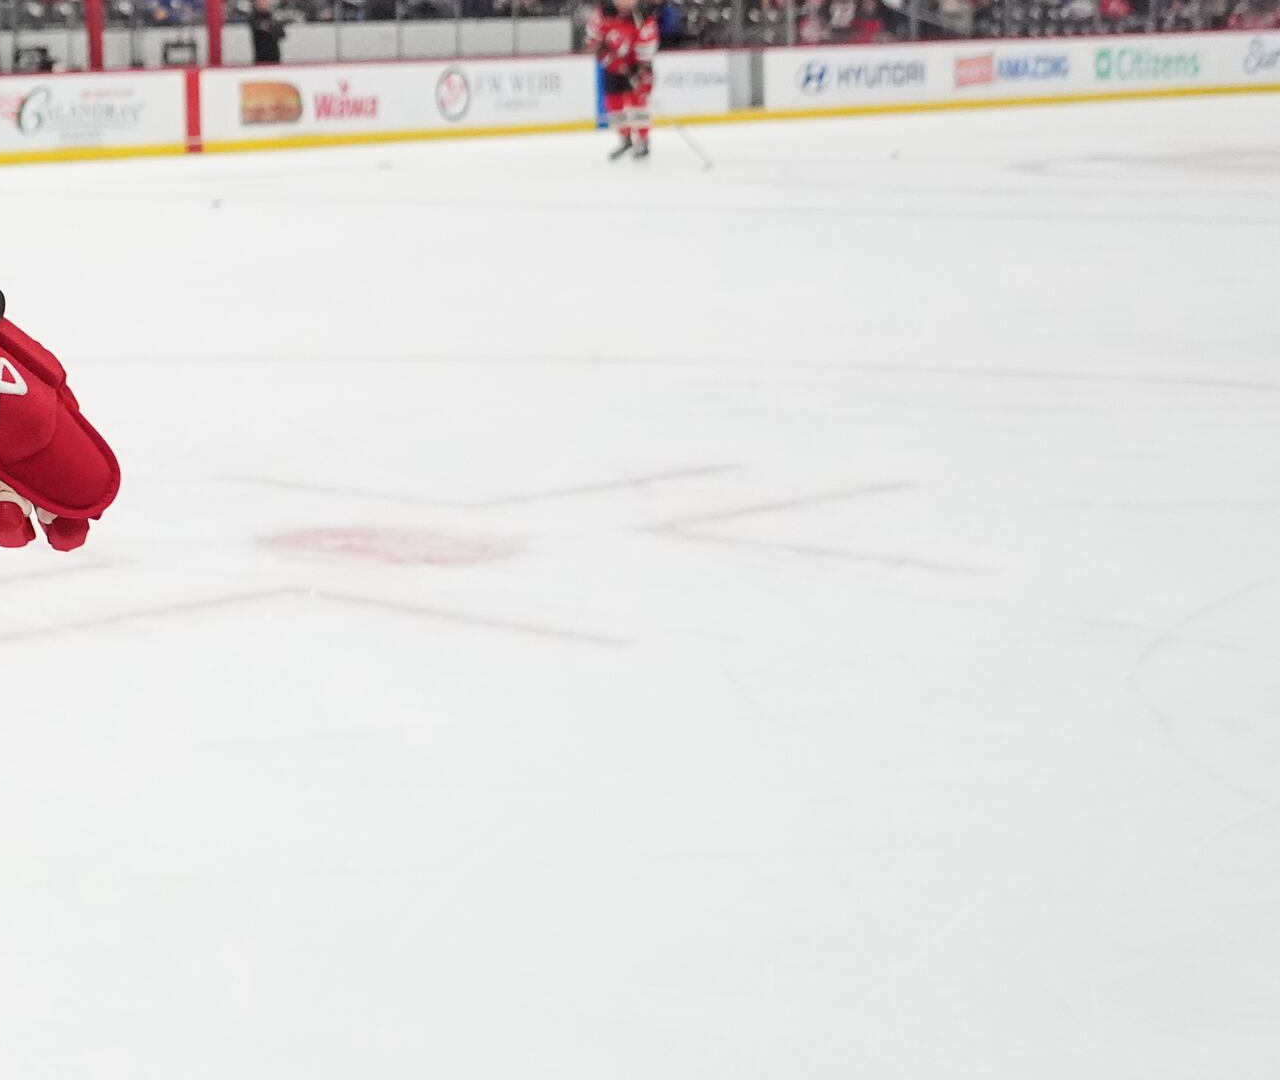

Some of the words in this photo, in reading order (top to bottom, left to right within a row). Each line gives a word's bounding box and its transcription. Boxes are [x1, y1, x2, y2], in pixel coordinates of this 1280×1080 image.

[837, 59, 925, 88] HYUNDAI
[1116, 47, 1201, 80] Citizens
[314, 91, 378, 120] Wawa
